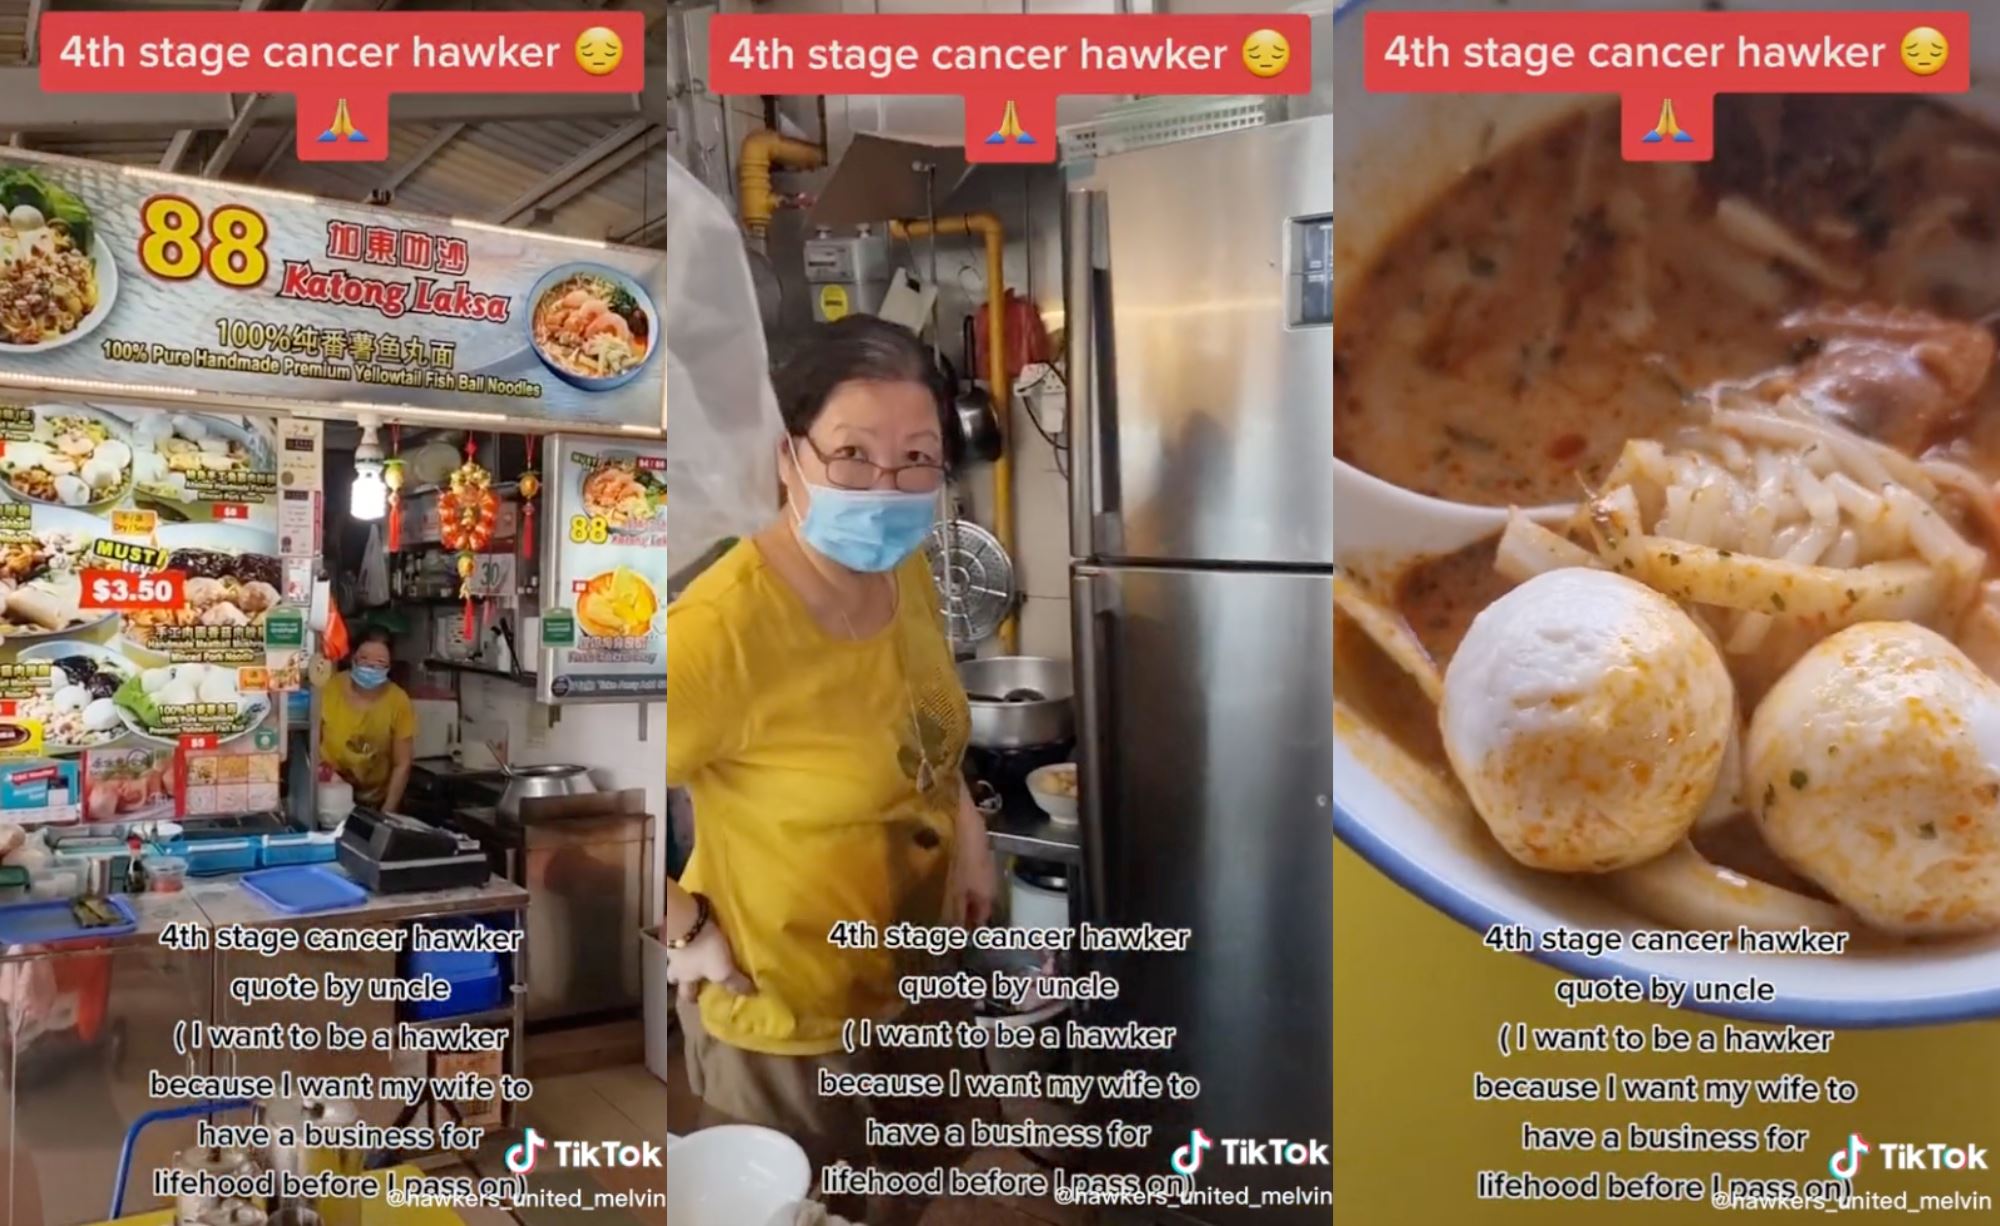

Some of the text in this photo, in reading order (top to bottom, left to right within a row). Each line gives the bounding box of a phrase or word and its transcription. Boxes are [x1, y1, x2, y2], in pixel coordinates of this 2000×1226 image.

[138, 193, 269, 290] 88
[277, 260, 511, 323] Katong Laksa
[102, 338, 542, 397] 100% Pure Handmade Premium Yellowtail Fish Ball Noodles
[569, 513, 608, 544] 88
[92, 578, 173, 603] $3.50
[481, 562, 500, 586] 30
